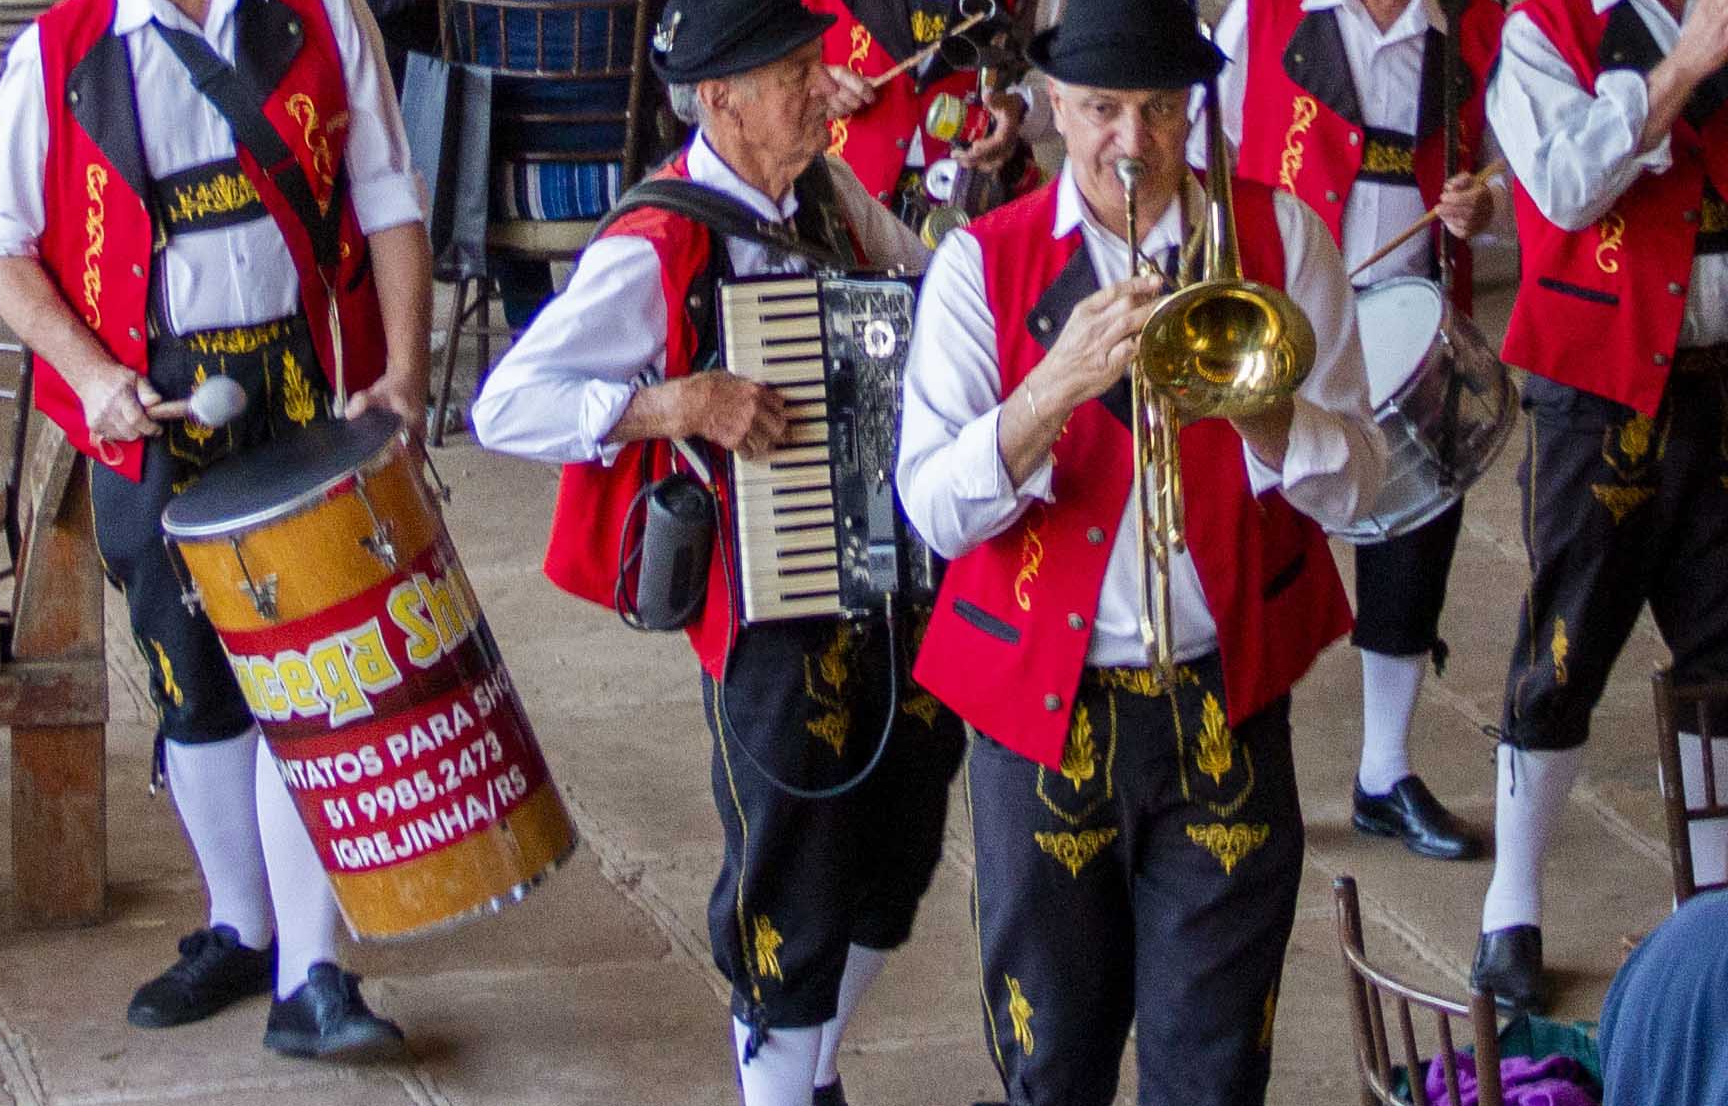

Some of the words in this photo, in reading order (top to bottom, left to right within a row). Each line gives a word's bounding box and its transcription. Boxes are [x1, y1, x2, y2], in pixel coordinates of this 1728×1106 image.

[323, 797, 356, 830] 51
[357, 729, 504, 824] 9985.2473
[386, 701, 474, 767] PARA
[330, 763, 528, 870] IGREJINHA/RS
